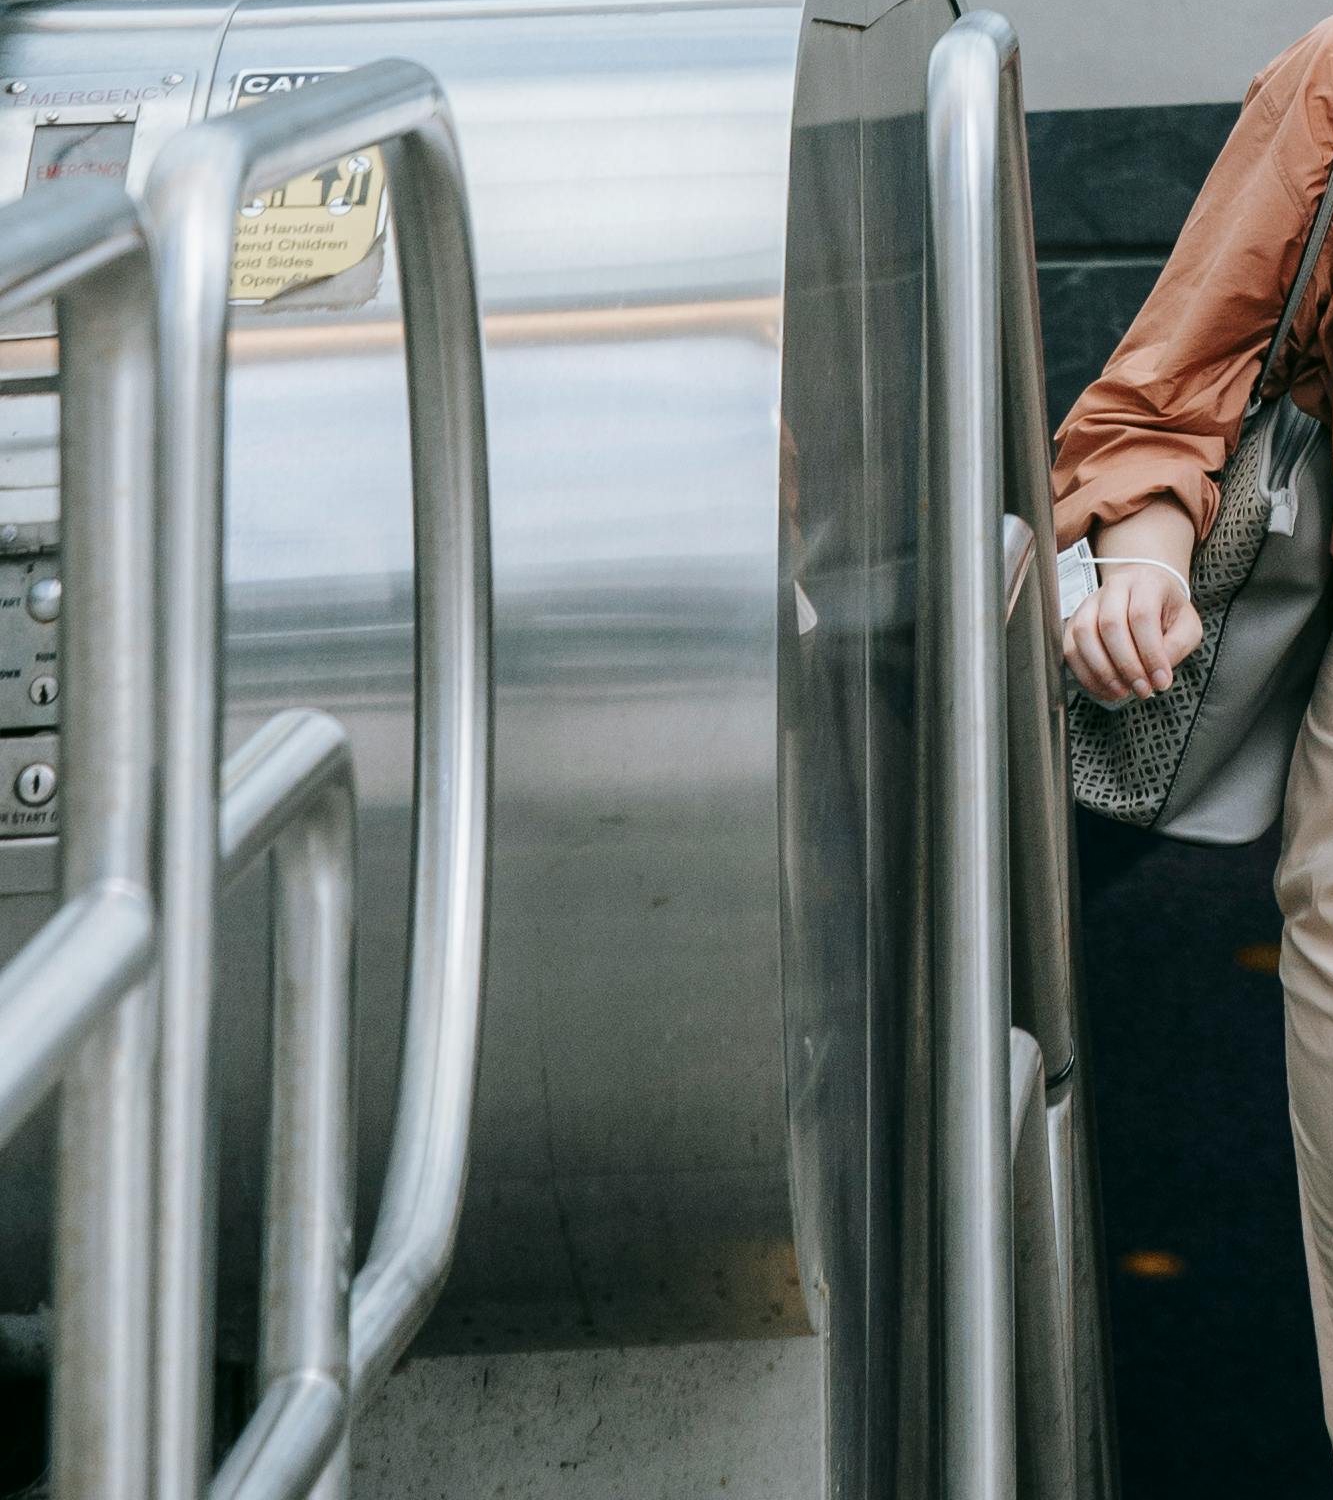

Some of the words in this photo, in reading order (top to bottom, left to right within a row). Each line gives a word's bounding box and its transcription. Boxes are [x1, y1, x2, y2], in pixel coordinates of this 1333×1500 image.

[14, 85, 177, 107] EMERGENCY
[264, 222, 335, 235] Handrail
[278, 239, 349, 252] Children
[267, 256, 314, 269] Sides
